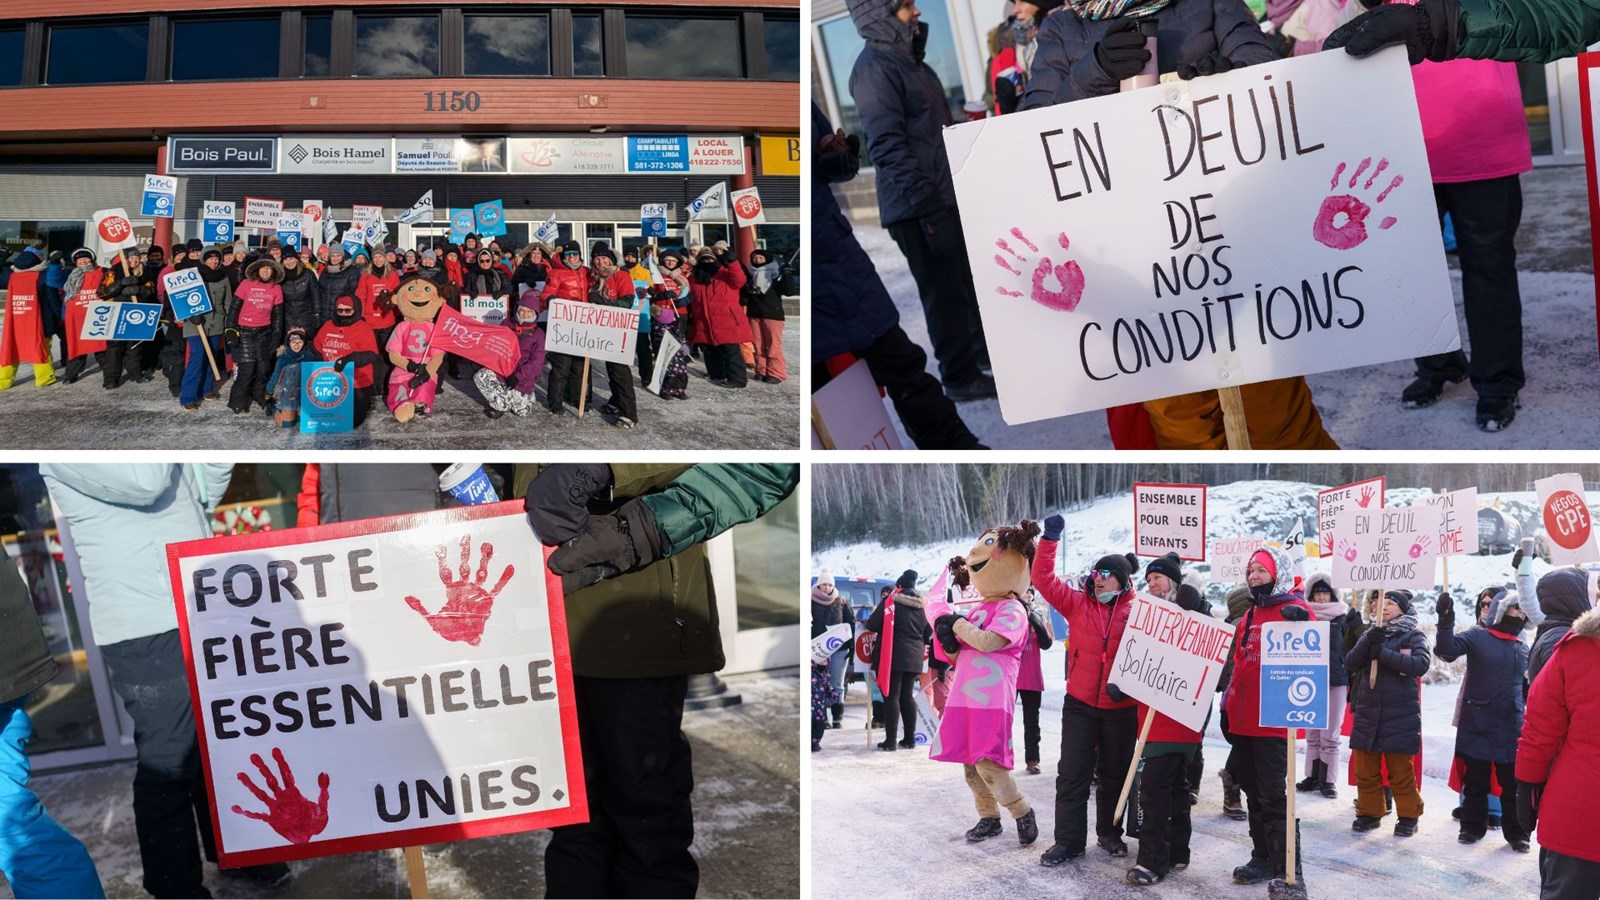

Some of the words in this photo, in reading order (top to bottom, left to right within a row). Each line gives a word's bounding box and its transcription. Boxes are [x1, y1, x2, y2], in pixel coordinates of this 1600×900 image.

[424, 91, 480, 111] 1150
[1039, 121, 1113, 204] EN
[1149, 74, 1326, 184] DEUIL
[181, 147, 219, 161] Bois
[312, 147, 341, 158] Bois
[343, 147, 385, 158] Hamel
[397, 151, 431, 159] Samuel
[248, 201, 279, 209] ENSEMBLE
[742, 200, 760, 214] CPE
[106, 221, 129, 238] CPE
[1161, 192, 1225, 250] DE
[1151, 244, 1232, 300] NOS
[463, 299, 475, 308] 18
[478, 300, 504, 308] mois
[146, 310, 160, 326] CSQ
[551, 302, 640, 331] INTERVENANTE
[1078, 265, 1365, 383] CONDITIONS
[407, 329, 427, 354] 3
[620, 331, 627, 353] !
[463, 480, 487, 501] Tim
[1139, 493, 1197, 506] ENSEMBLE
[1320, 489, 1352, 506] FORTE
[1550, 494, 1580, 515] NÉGOS
[1139, 514, 1170, 526] POUR
[1179, 516, 1199, 528] LES
[1354, 515, 1370, 535] EN
[1380, 509, 1418, 535] DEUIL
[1556, 505, 1588, 536] CPE
[1139, 536, 1189, 550] ENFANTS
[1377, 538, 1391, 552] DE
[1370, 552, 1391, 568] NOS
[192, 547, 379, 613] FORTE
[1350, 562, 1416, 583] CONDITIONS
[1129, 598, 1234, 665] INTERVENANTE
[201, 615, 350, 681] FIÈRE
[1192, 665, 1209, 706] !
[208, 658, 559, 743] ESSENTIELLE
[1286, 710, 1317, 725] CSQ
